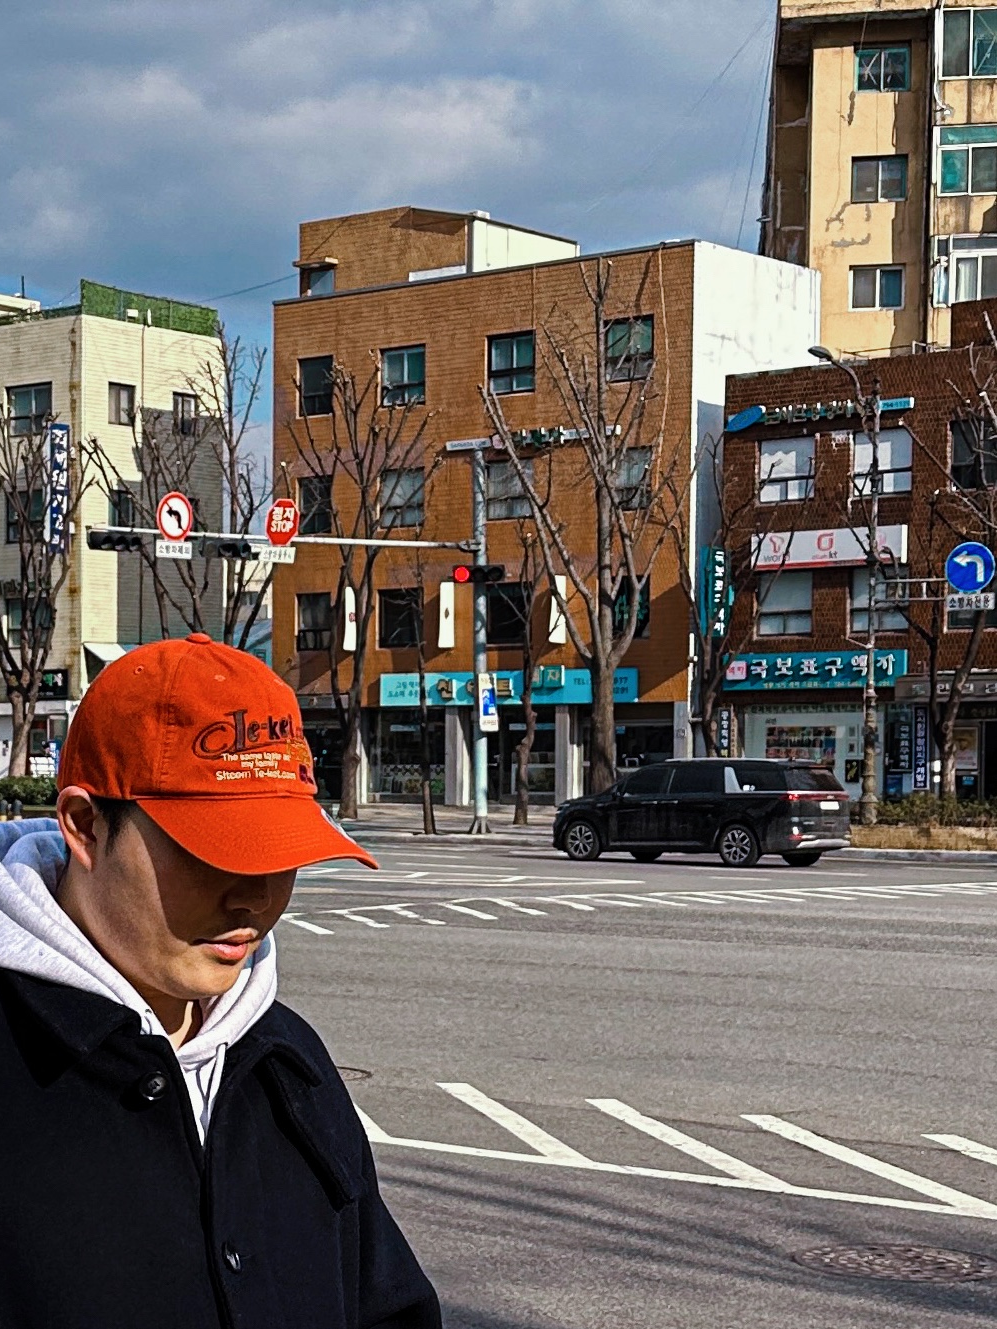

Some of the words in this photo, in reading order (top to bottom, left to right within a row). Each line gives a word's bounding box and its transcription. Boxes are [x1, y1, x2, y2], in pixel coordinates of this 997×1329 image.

[272, 507, 294, 520] 정지
[271, 520, 294, 533] STOP
[948, 595, 990, 608] 소방차전용
[221, 753, 239, 761] The
